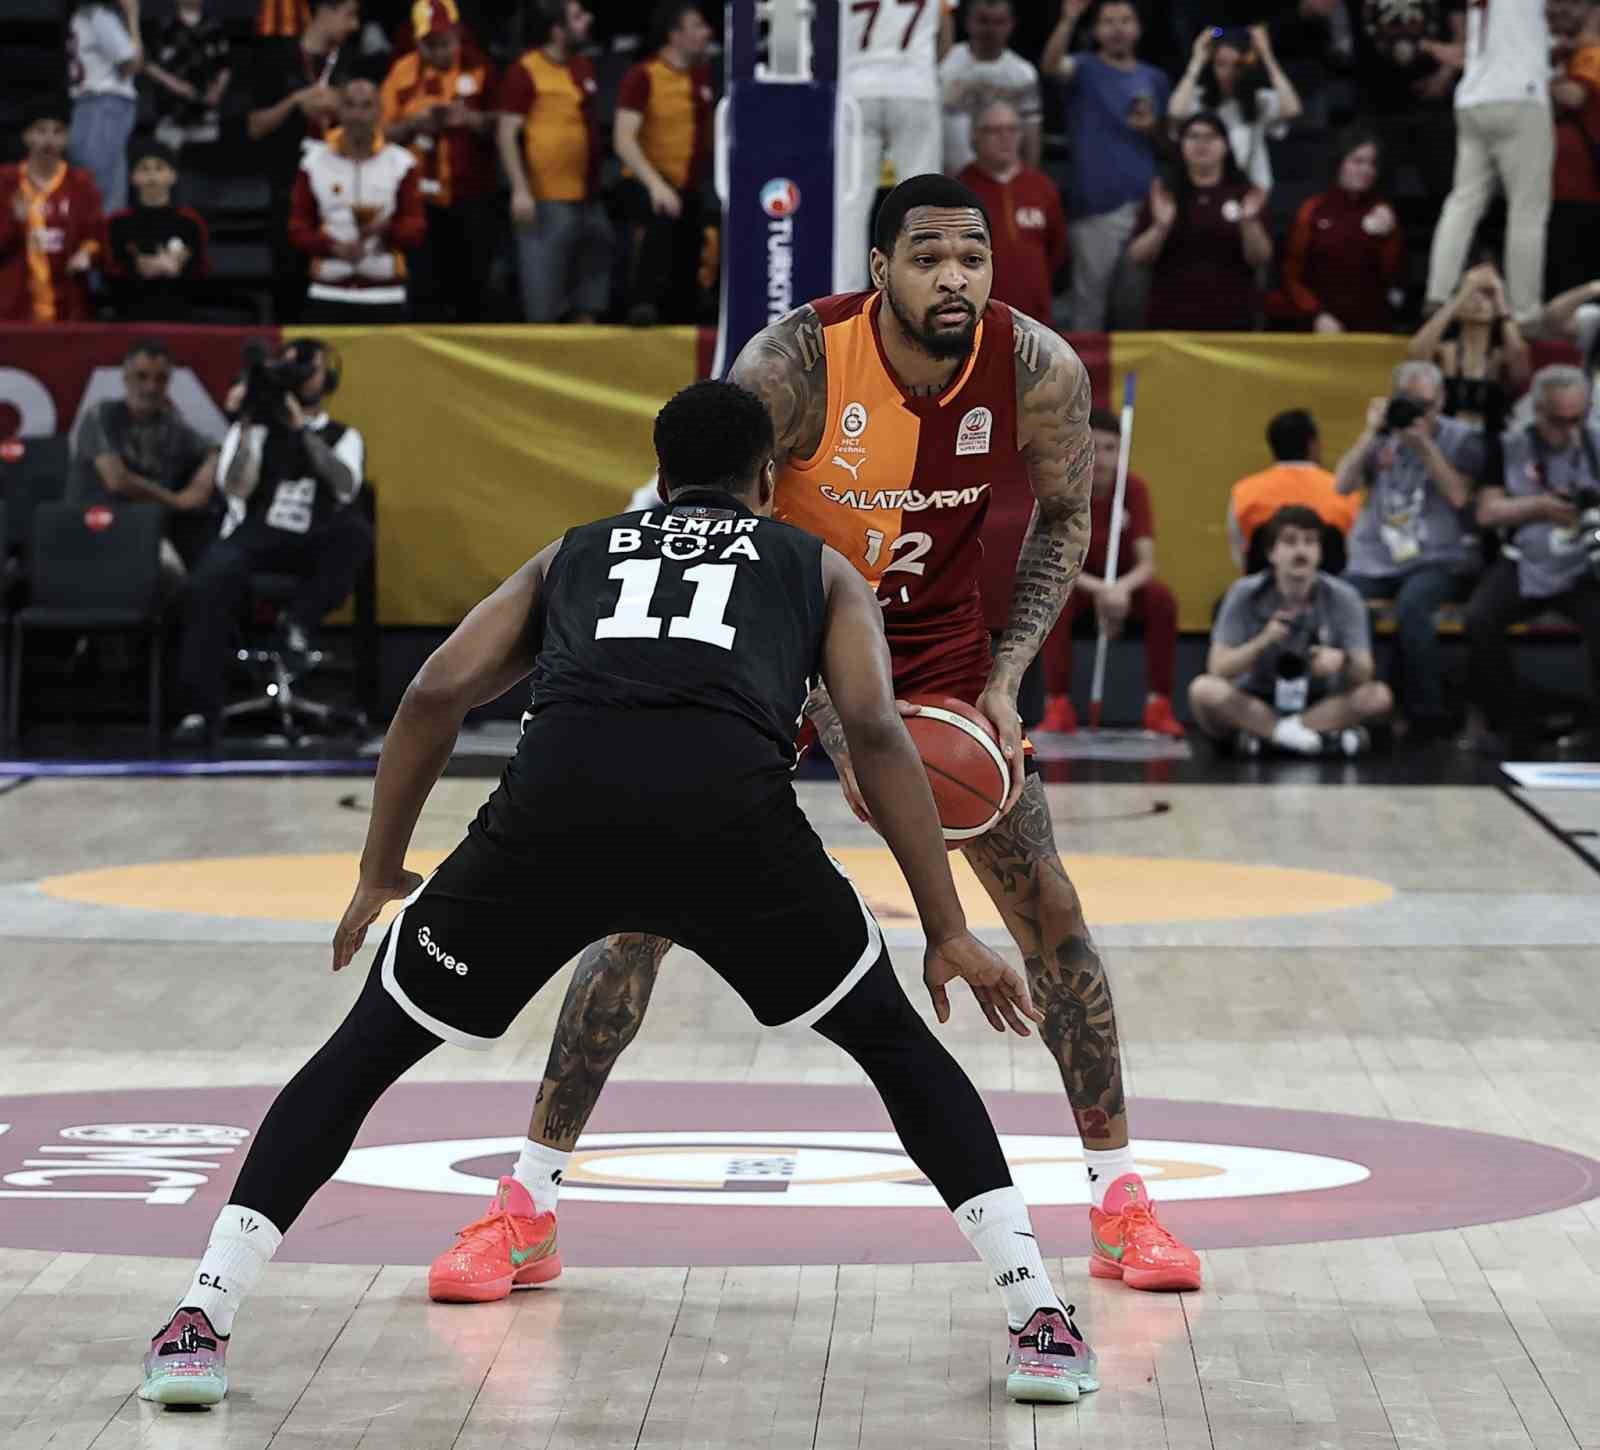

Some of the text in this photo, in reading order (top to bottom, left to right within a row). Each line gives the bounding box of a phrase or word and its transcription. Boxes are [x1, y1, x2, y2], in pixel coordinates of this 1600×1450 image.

[851, 0, 926, 50] 77
[819, 482, 991, 512] GALATASARAY
[639, 511, 760, 536] LEMAR
[864, 528, 933, 576] 12
[594, 557, 738, 651] 11
[417, 926, 469, 976] Govee
[198, 1272, 228, 1294] C.L.
